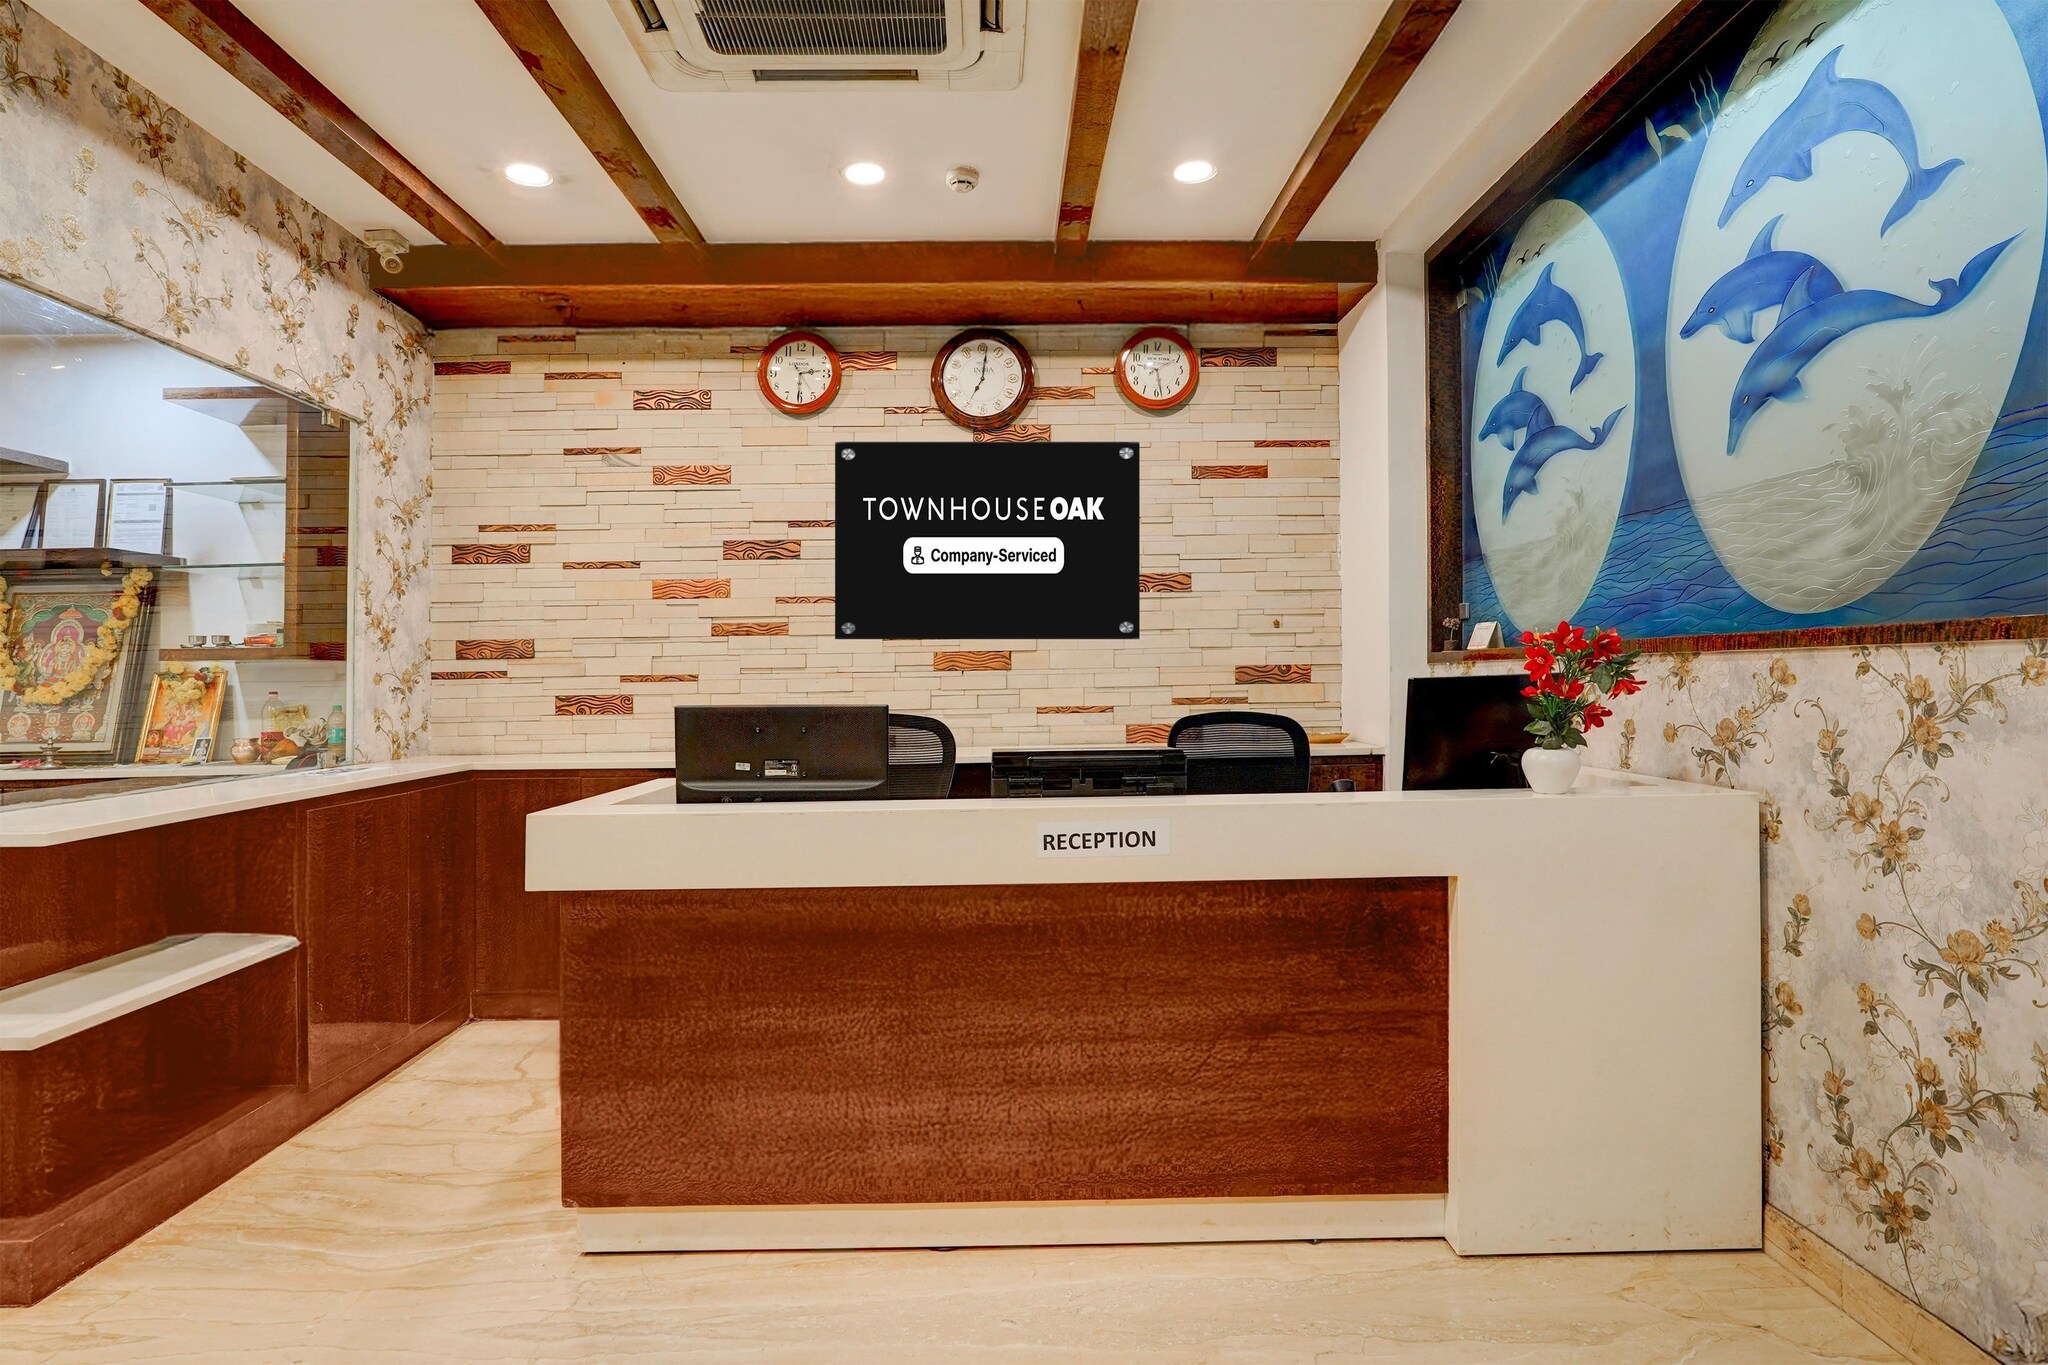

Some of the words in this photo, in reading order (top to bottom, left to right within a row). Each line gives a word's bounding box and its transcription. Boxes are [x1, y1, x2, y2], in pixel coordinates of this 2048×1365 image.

[786, 346, 792, 356] 11
[797, 343, 806, 351] 12
[1143, 344, 1148, 354] 11
[1154, 342, 1161, 351] 12
[775, 356, 783, 364] 10
[1133, 353, 1140, 362] 10
[863, 497, 1045, 521] TOWNHOUSE
[1050, 496, 1105, 521] OAK
[930, 547, 1057, 566] Company-Serviced
[1043, 830, 1156, 851] RECEPTION
